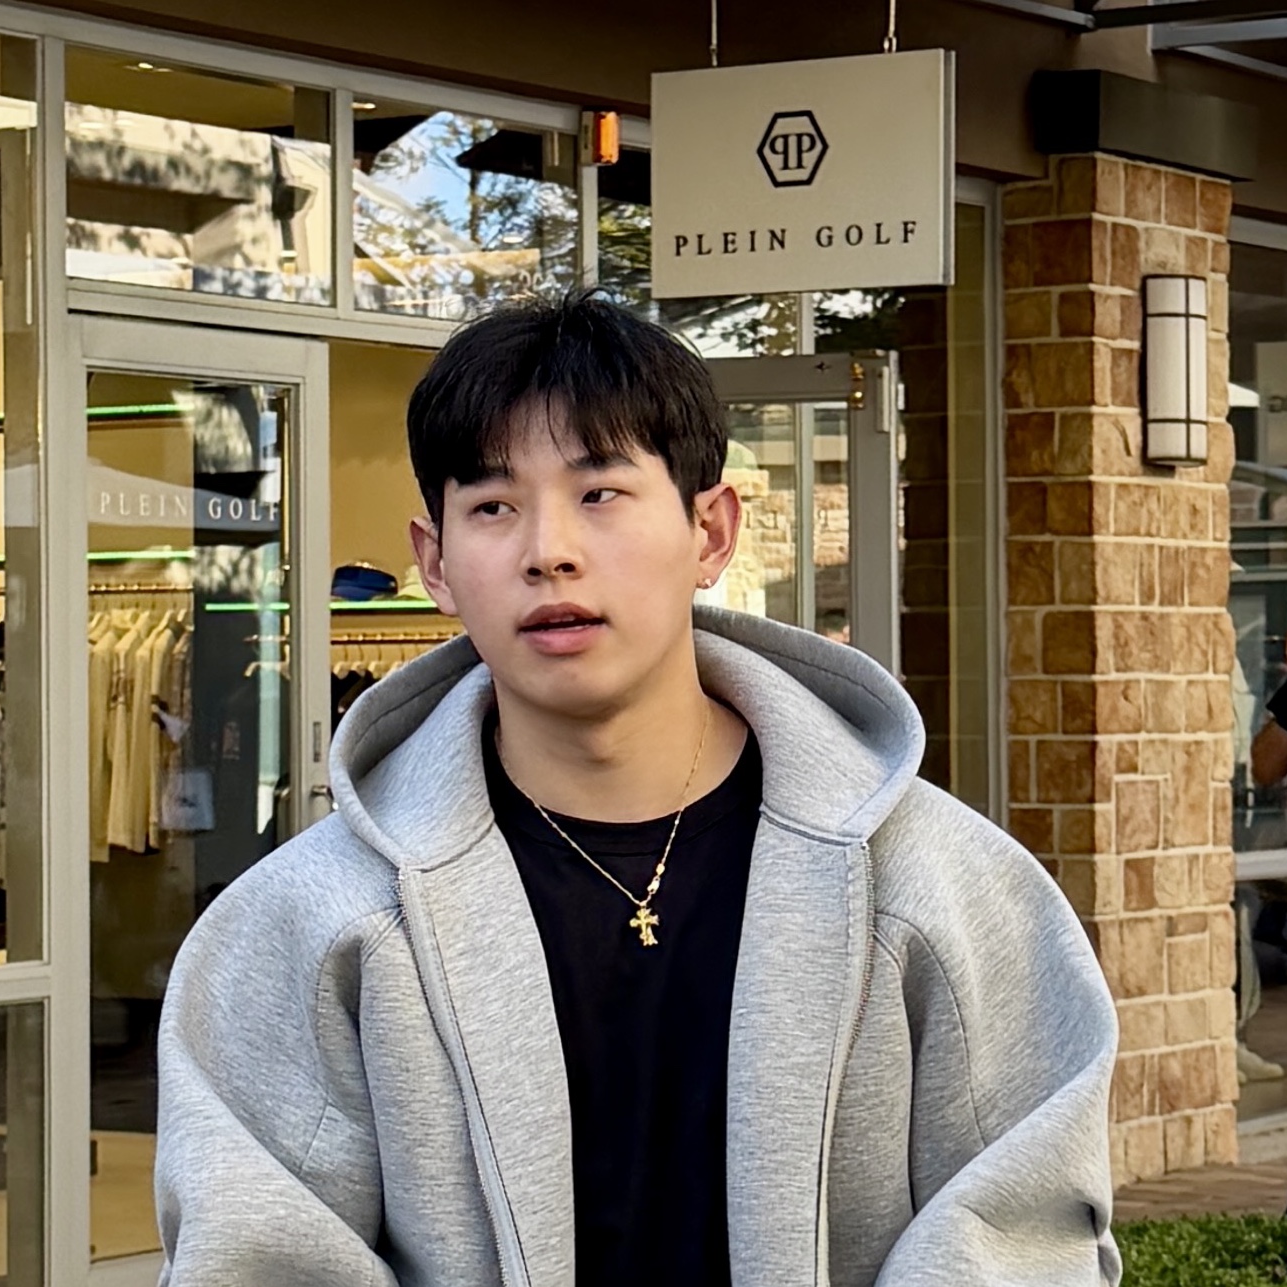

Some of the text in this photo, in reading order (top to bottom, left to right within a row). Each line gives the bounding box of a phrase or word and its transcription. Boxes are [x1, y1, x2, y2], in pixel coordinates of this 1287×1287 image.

[675, 220, 917, 257] PLEIN GOLF
[100, 492, 279, 522] PLEIN GOLF
